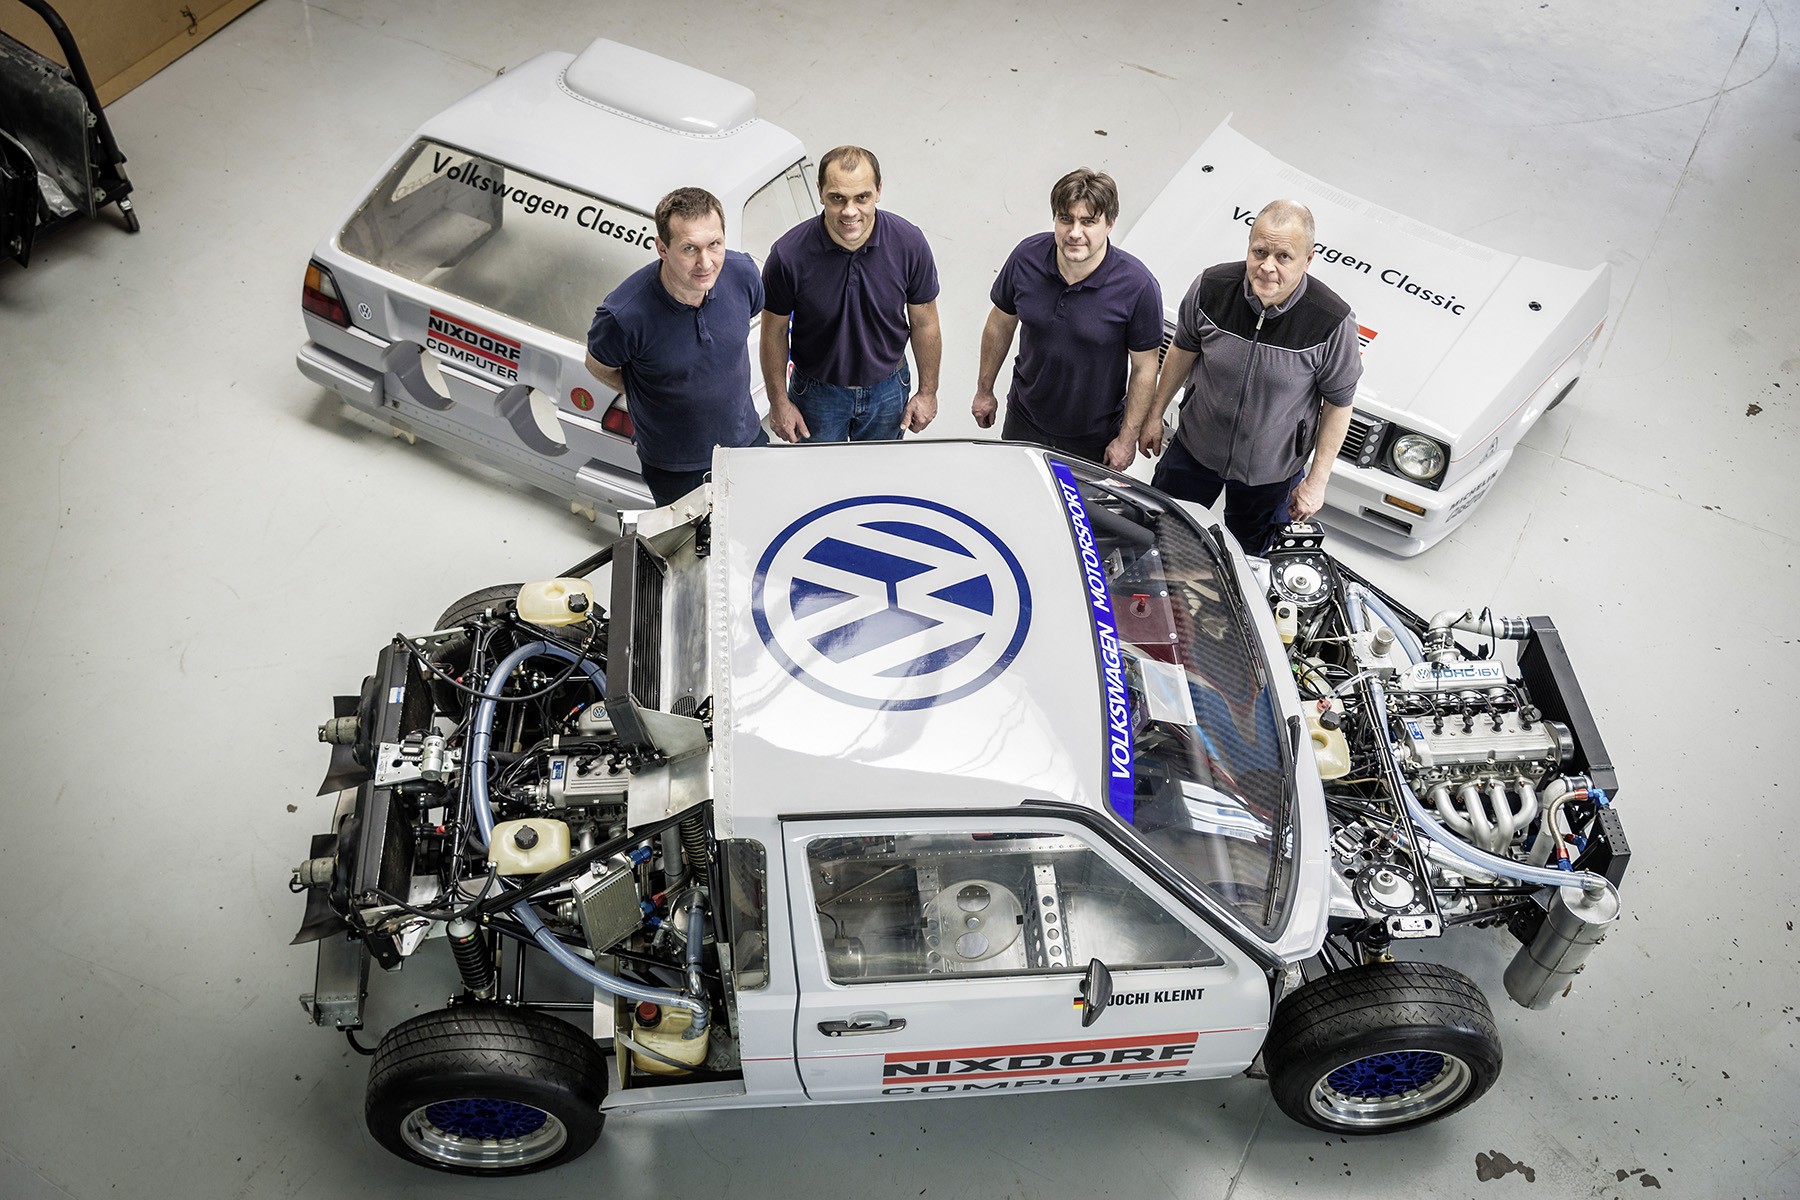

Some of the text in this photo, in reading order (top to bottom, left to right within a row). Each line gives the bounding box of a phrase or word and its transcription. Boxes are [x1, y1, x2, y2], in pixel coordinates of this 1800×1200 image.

[432, 152, 570, 219] Volkswagen
[576, 205, 656, 250] Classic
[1232, 206, 1466, 316] Voagen Classic
[426, 337, 518, 382] COMPUTER
[428, 316, 521, 361] NIXDORF
[1058, 477, 1131, 779] VOLKSWAGEN MOTORSPORT
[1107, 988, 1205, 1007] JOCHI KLEINT
[881, 1070, 1187, 1096] COMPUTER
[883, 1044, 1196, 1077] NIXDORF
